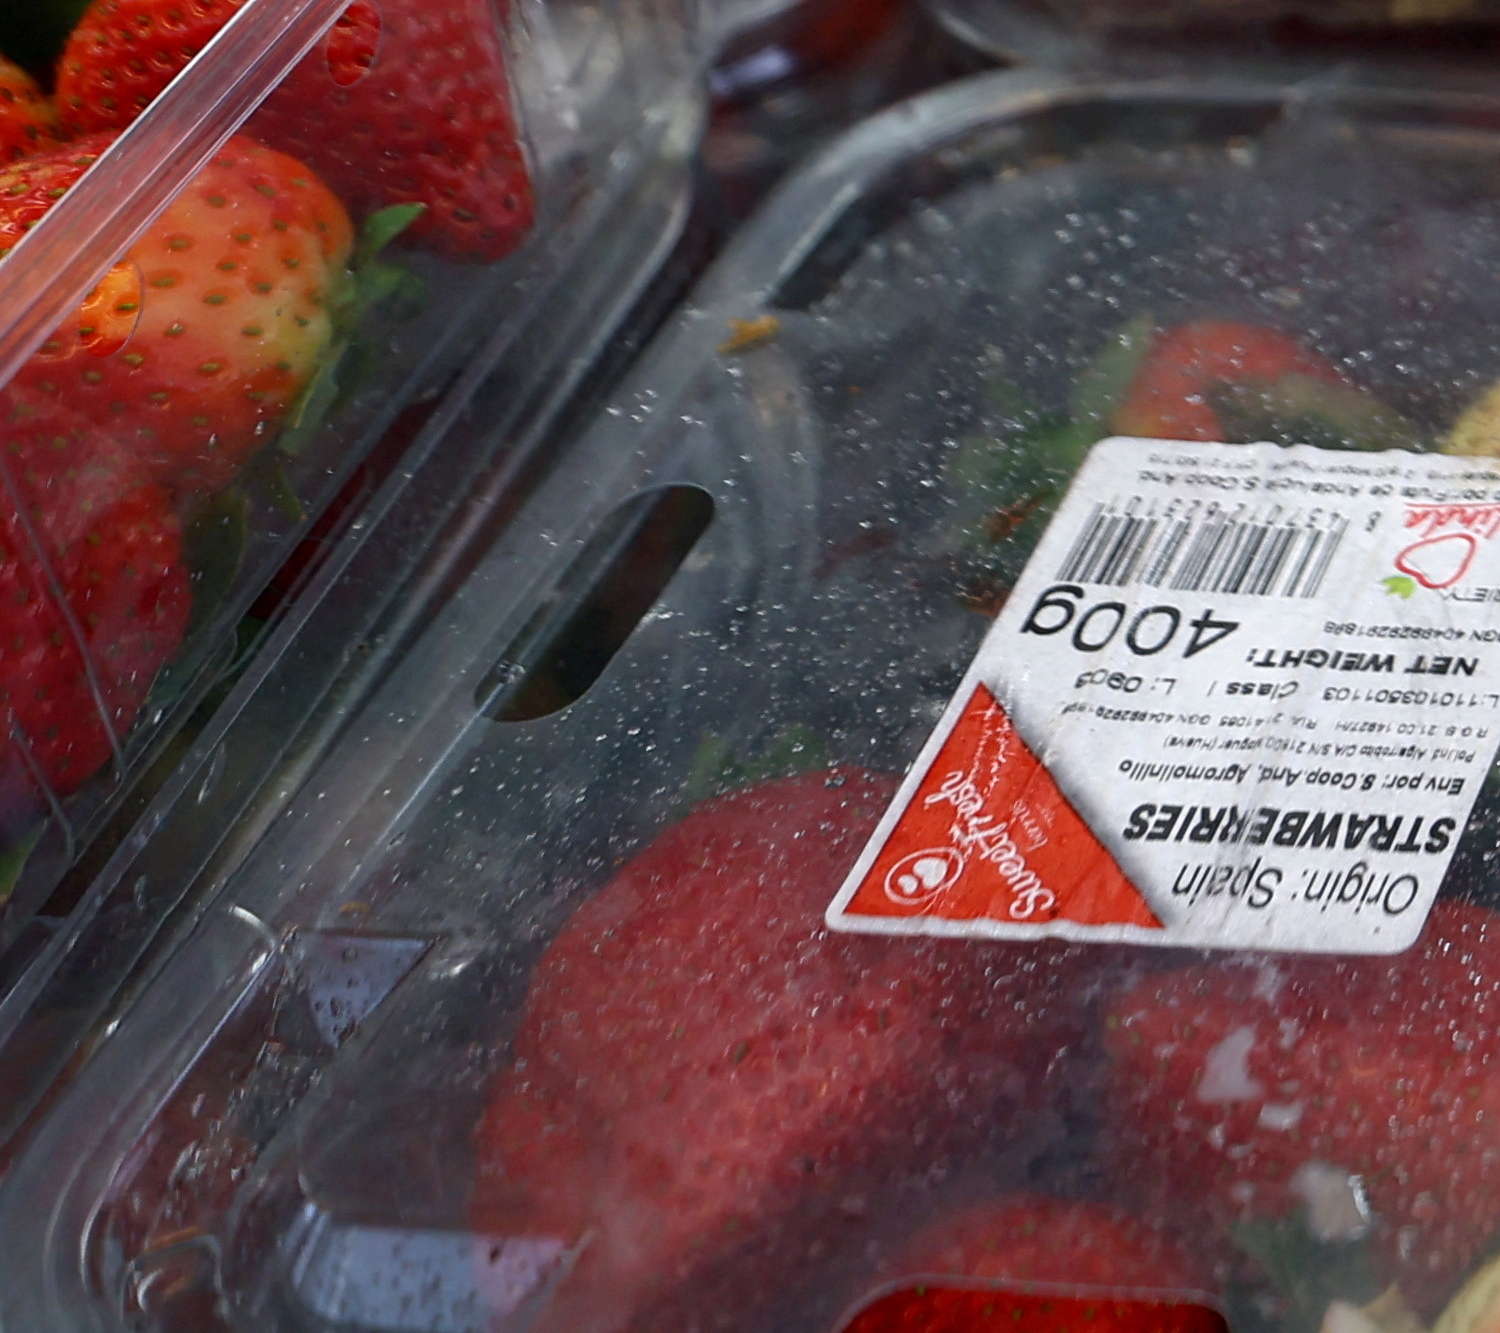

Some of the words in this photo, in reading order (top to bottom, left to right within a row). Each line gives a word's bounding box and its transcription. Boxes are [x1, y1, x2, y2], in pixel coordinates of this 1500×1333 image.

[1020, 585, 1240, 658] 400g
[1247, 649, 1395, 672] WEIGHT:
[1404, 656, 1478, 676] NET
[1226, 681, 1299, 699] Class
[1119, 760, 1251, 784] Agromolinillo
[1382, 773, 1424, 789] por:
[1425, 777, 1465, 795] Env
[1124, 804, 1453, 853] STRAWBERRIES
[1172, 857, 1282, 909] Spain
[1292, 861, 1419, 914] Origin:
